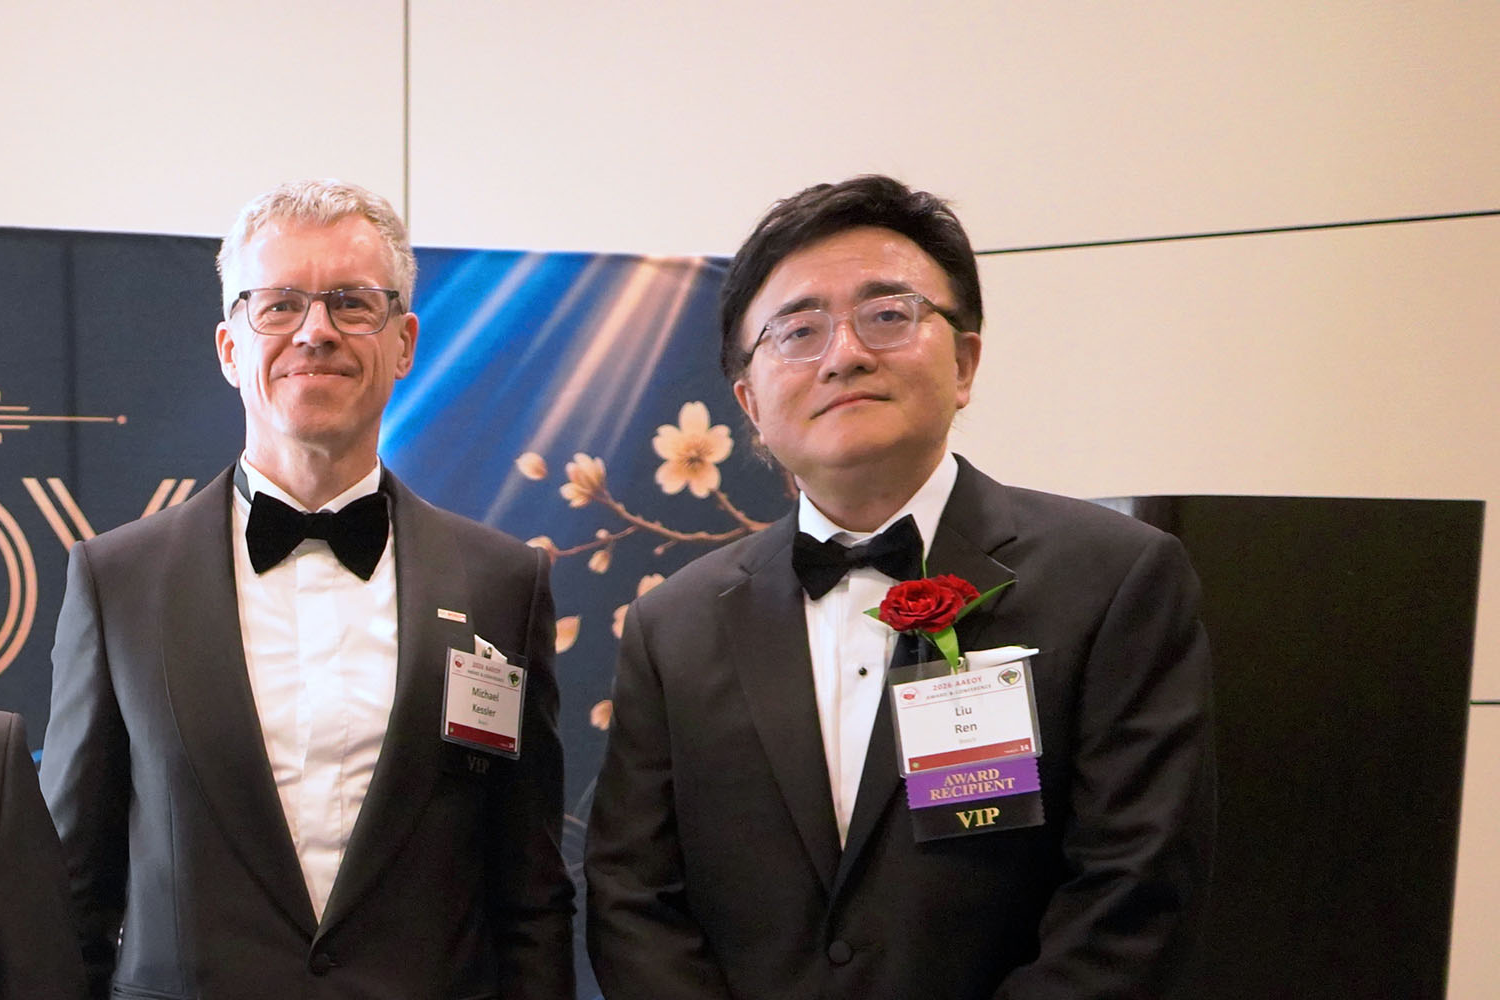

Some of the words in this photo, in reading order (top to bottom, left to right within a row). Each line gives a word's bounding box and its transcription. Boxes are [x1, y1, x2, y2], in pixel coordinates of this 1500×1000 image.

[471, 687, 499, 702] Michael
[471, 704, 496, 717] Kessler
[955, 706, 972, 717] Liu
[955, 722, 977, 734] Ren
[944, 768, 1000, 788] AWARD
[930, 777, 1015, 800] RECIPIENT
[956, 807, 1000, 829] VIP
